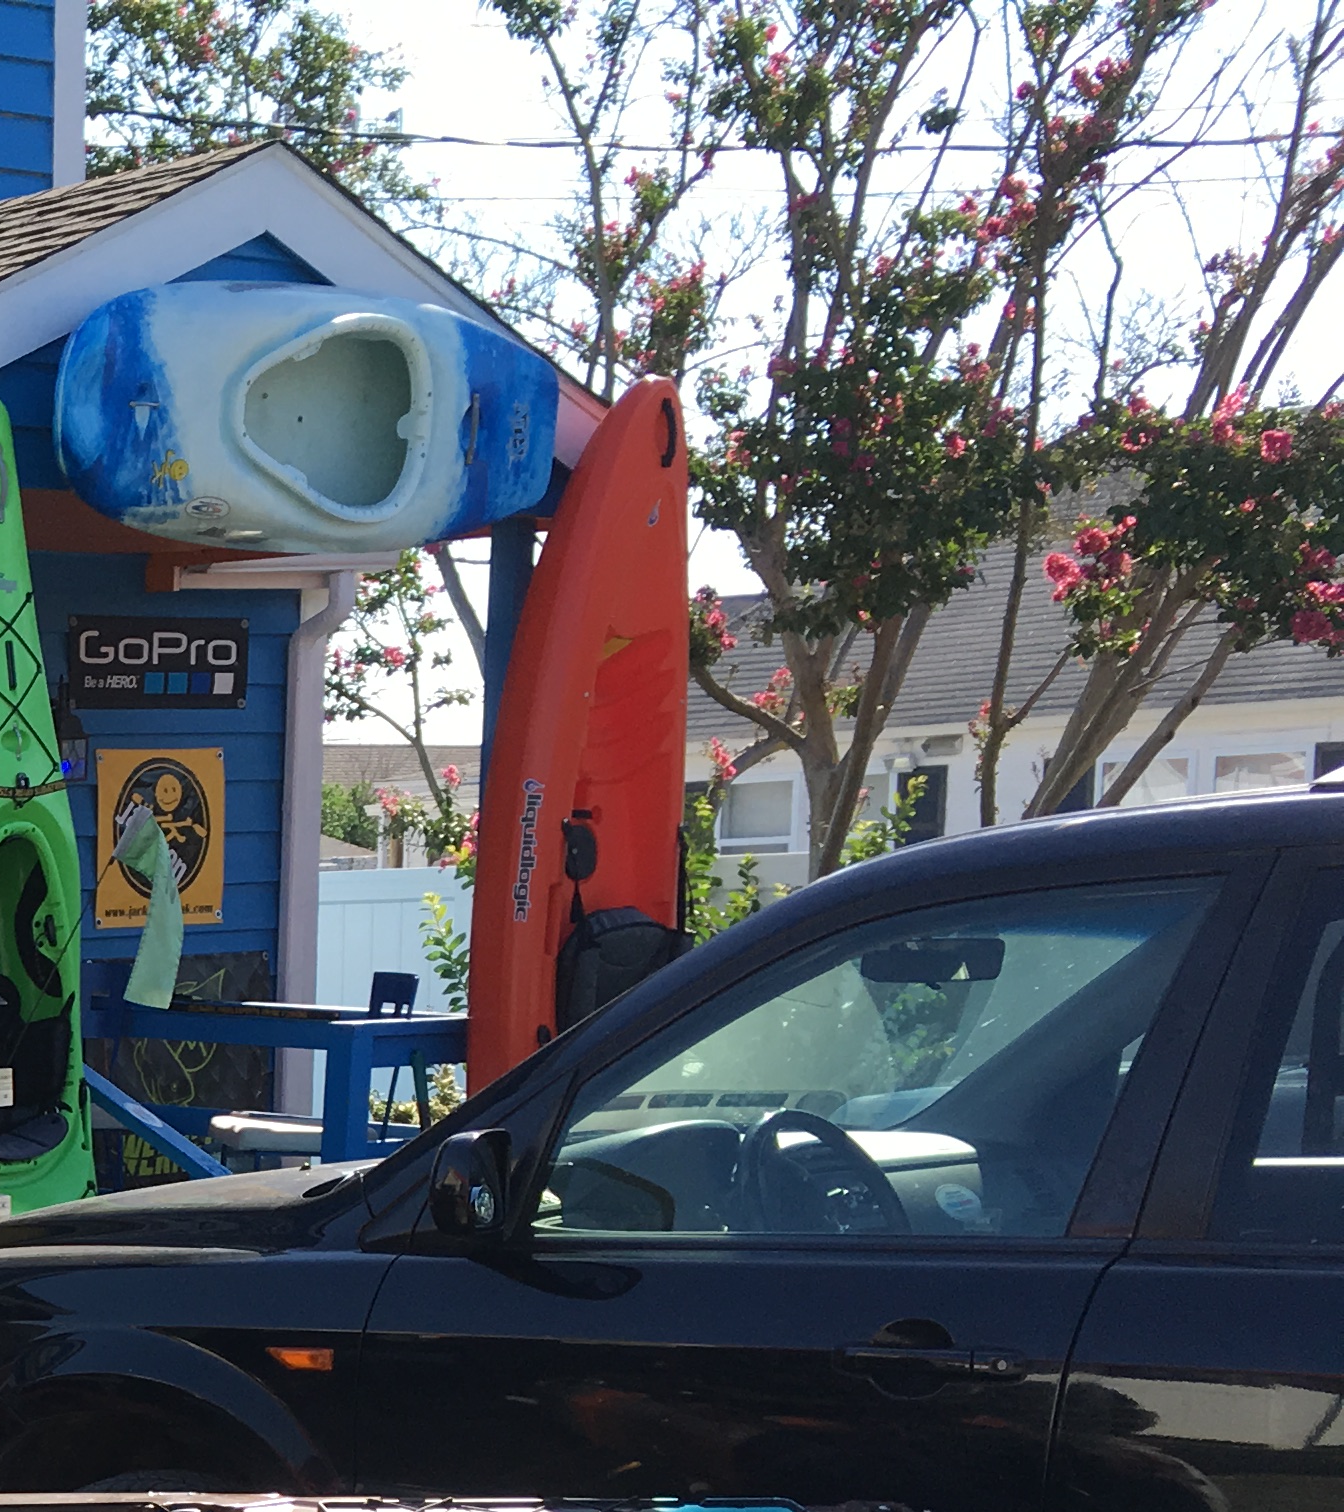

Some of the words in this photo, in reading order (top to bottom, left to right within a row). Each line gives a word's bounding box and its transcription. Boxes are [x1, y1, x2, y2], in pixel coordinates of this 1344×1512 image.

[78, 630, 238, 666] GoPro
[84, 675, 97, 688] Be
[98, 678, 105, 688] a
[512, 793, 543, 922] liquidlogic
